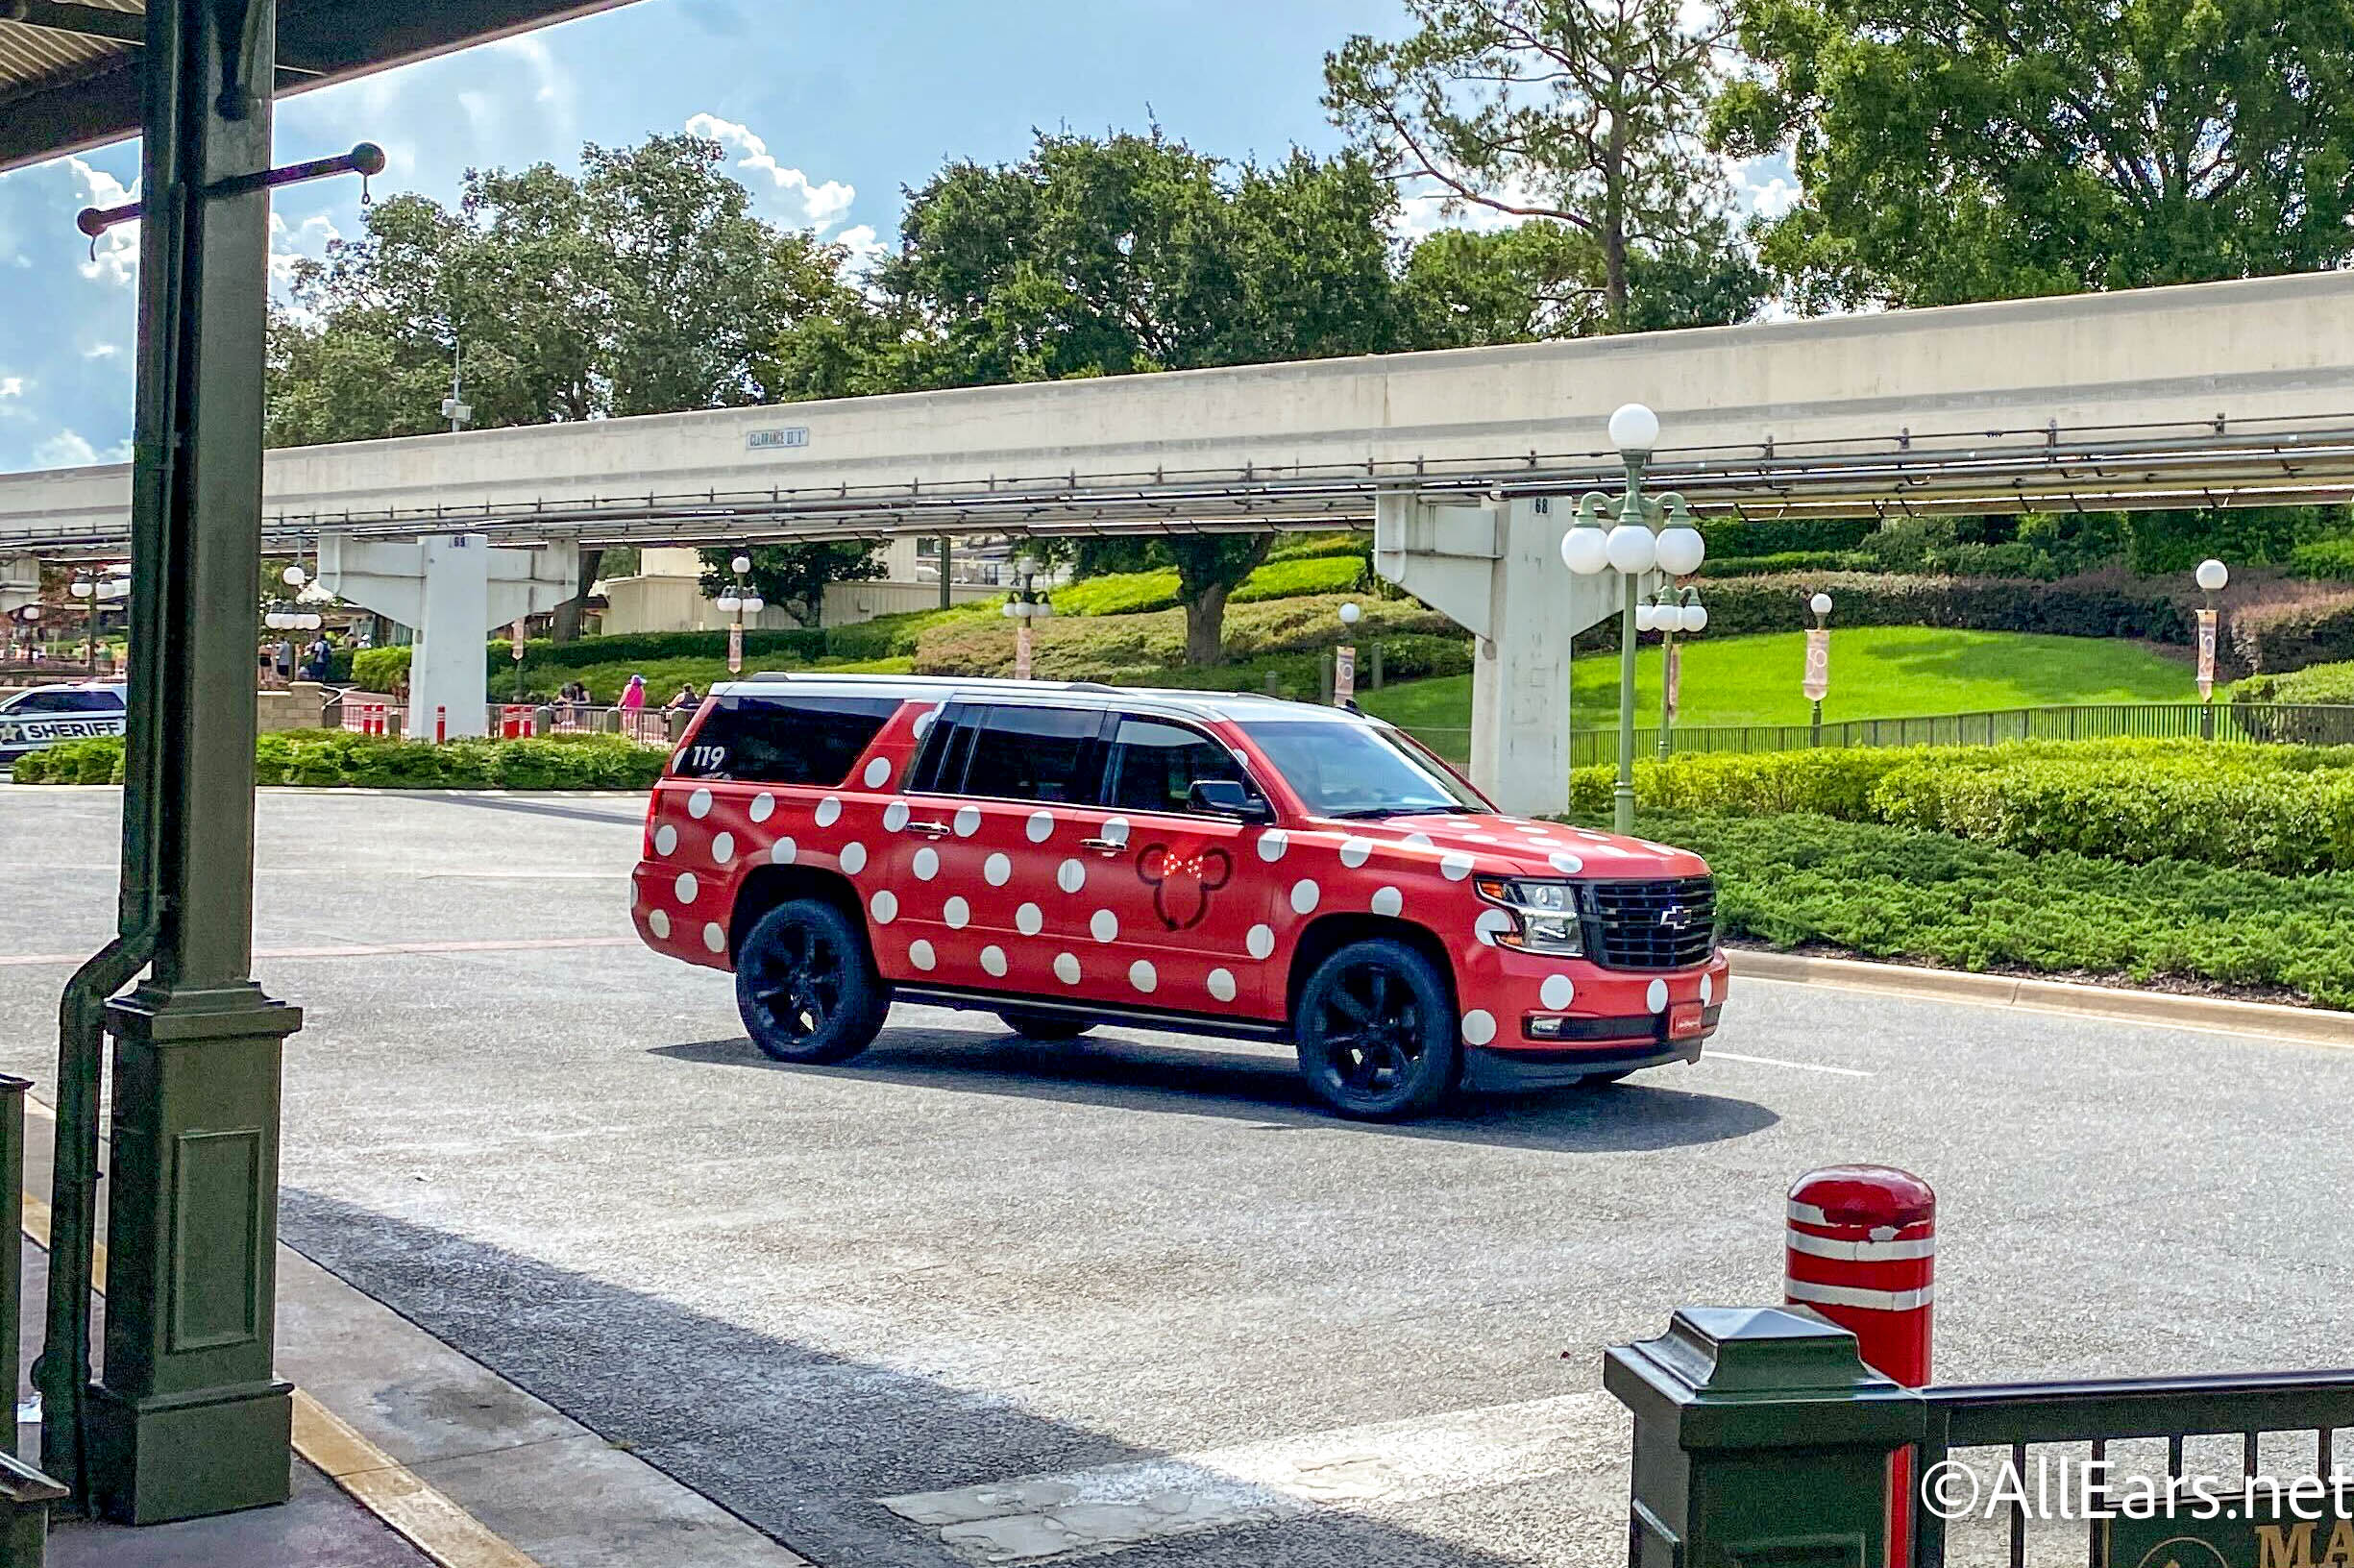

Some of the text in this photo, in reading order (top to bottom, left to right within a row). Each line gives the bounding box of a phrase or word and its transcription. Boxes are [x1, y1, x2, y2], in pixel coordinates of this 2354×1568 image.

[1535, 498, 1548, 514] 68
[1807, 647, 1827, 675] 50
[27, 722, 120, 739] SHERIFF
[692, 746, 725, 771] 119
